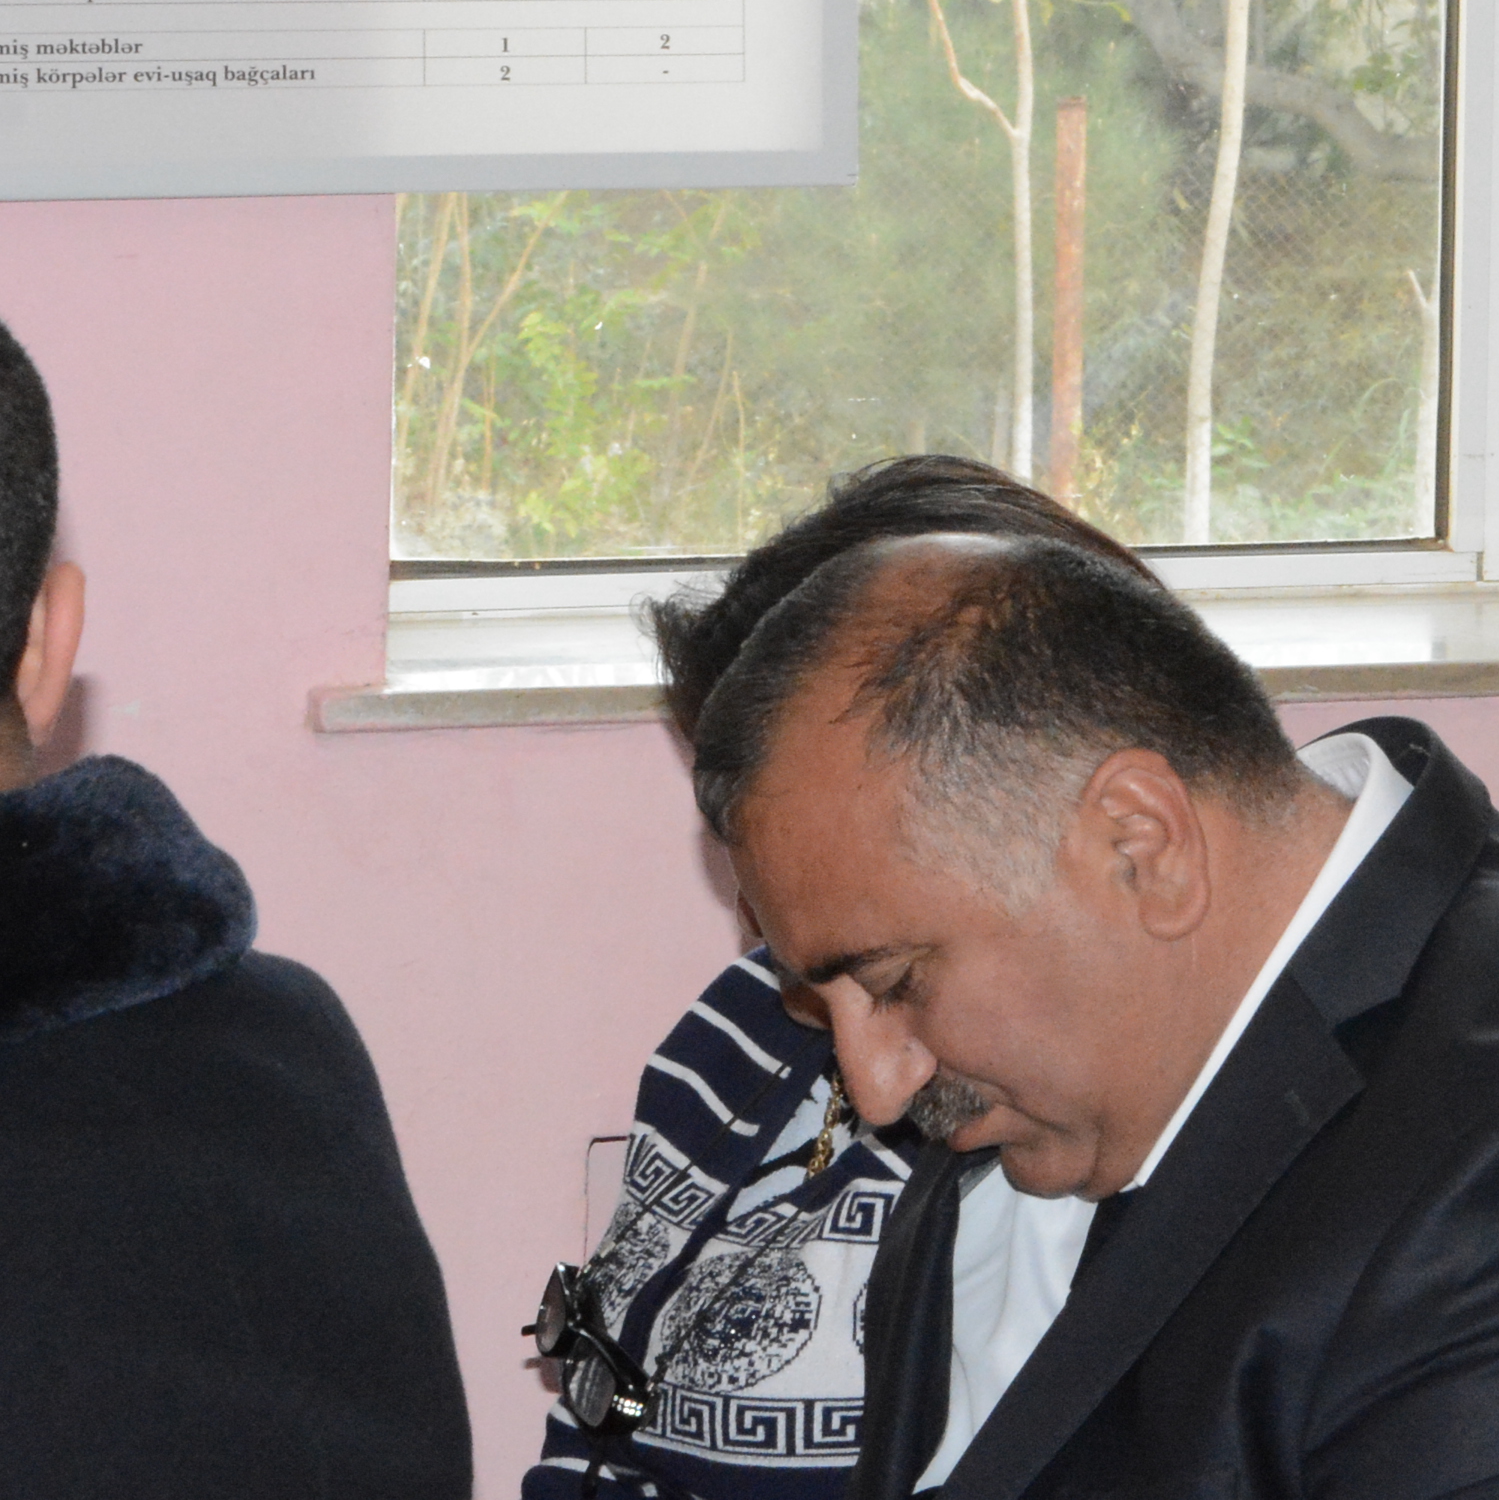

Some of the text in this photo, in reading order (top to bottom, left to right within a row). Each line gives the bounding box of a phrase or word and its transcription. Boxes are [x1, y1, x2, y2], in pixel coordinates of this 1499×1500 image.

[36, 37, 144, 55] məktəblər
[502, 37, 509, 53] 1
[659, 33, 671, 50] 2
[36, 66, 128, 90] körpələr
[133, 65, 218, 88] evi-uşaq
[223, 64, 315, 87] bağçaları
[499, 65, 511, 82] 2
